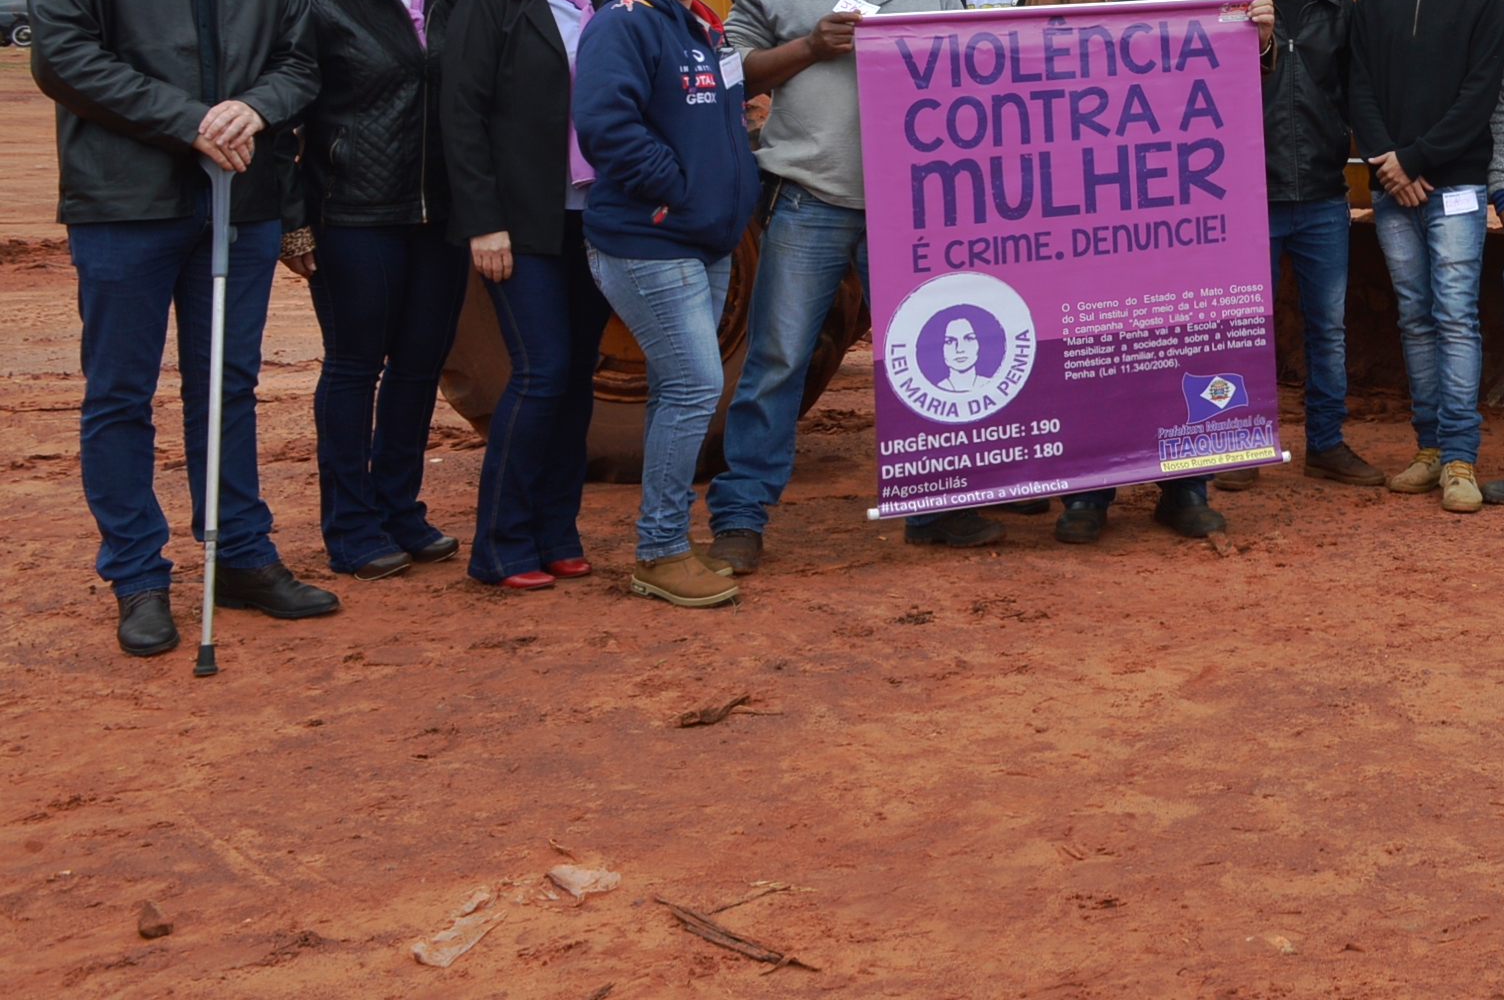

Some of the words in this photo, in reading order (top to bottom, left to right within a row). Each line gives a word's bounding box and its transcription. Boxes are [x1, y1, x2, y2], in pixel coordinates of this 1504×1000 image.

[895, 15, 1220, 90] VIOLÊNCIA
[686, 91, 717, 105] GEOX
[904, 83, 1161, 153] CONTRA
[1179, 78, 1224, 133] A
[910, 137, 1227, 230] MULHER
[912, 236, 931, 273] É
[944, 231, 1064, 270] CRIME.
[1071, 214, 1227, 259] DENUNCIE!
[1061, 303, 1070, 312] O
[1077, 300, 1119, 311] Governo
[1125, 297, 1138, 305] do
[1144, 292, 1176, 303] Estado
[1182, 290, 1194, 299] de
[1200, 288, 1223, 297] Mato
[1230, 284, 1264, 294] Grosso
[1062, 315, 1074, 324] do
[1079, 312, 1094, 322] Sul
[1100, 309, 1128, 320] institui
[1133, 308, 1148, 318] por
[1152, 304, 1174, 313] meio
[1178, 302, 1189, 310] da
[1194, 300, 1207, 309] Lei
[1075, 322, 1123, 333] campanha
[1222, 305, 1264, 318] programa
[1100, 334, 1113, 342] da
[1119, 330, 1149, 340] Penha
[1155, 327, 1168, 335] vai
[1174, 326, 1181, 334] a
[1229, 316, 1265, 327] visando
[1063, 345, 1115, 358] sensibilizar
[1133, 336, 1178, 350] sociedade
[1184, 334, 1209, 343] sobre
[1215, 332, 1221, 340] a
[1226, 327, 1266, 338] violência
[1064, 357, 1112, 369] doméstica
[1122, 352, 1157, 362] familiar,
[1166, 346, 1202, 357] divulgar
[1212, 342, 1225, 351] Lei
[1227, 340, 1252, 349] Maria
[1254, 338, 1266, 346] da
[891, 343, 909, 376] LEI
[900, 377, 959, 418] MARIA
[968, 394, 997, 415] DA
[996, 329, 1031, 397] PENHA
[1064, 370, 1095, 380] Penha
[1099, 366, 1117, 378] (Lei
[880, 430, 969, 456] URGÊNCIA
[972, 423, 1025, 443] LIGUE:
[1030, 418, 1060, 435] 190
[1158, 424, 1204, 438] Prefeitura
[1206, 415, 1252, 431] Municipal
[1159, 420, 1274, 460] ITAQUIRAÍ
[881, 454, 972, 479] DENÚNCIA
[975, 447, 1029, 466] LIGUE:
[1034, 442, 1063, 458] 180
[1163, 461, 1189, 471] Nosso
[1191, 457, 1216, 467] Rumo
[1218, 454, 1224, 464] é
[1225, 453, 1244, 463] Para
[1246, 449, 1273, 460] Frente
[881, 496, 947, 514] #Itaquiraí
[950, 488, 994, 504] contra
[998, 488, 1006, 497] a
[1009, 478, 1069, 496] violência
[882, 476, 968, 498] #AgostoLilás
